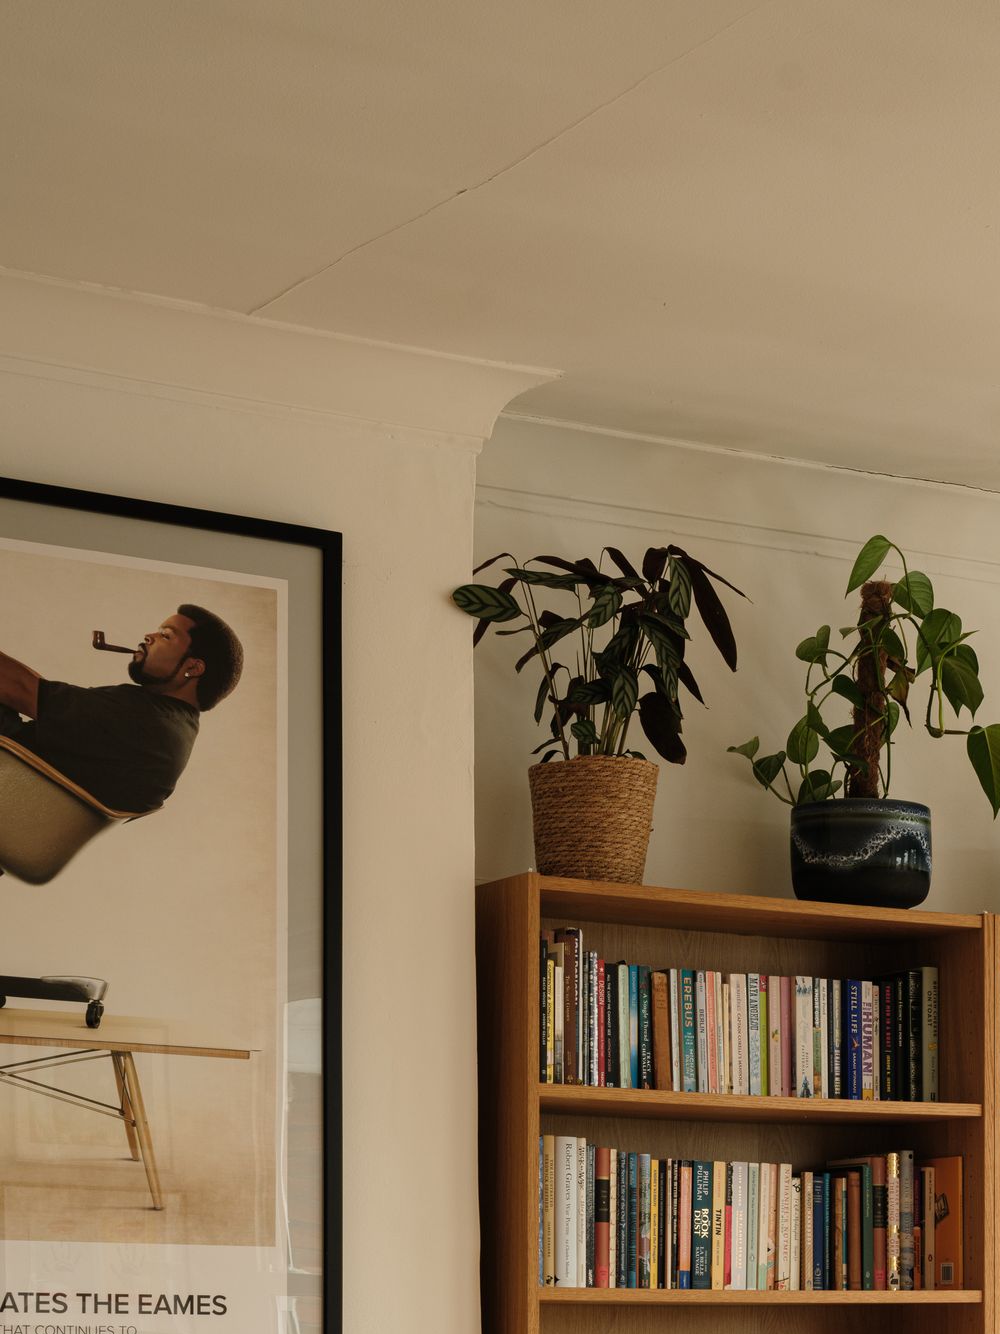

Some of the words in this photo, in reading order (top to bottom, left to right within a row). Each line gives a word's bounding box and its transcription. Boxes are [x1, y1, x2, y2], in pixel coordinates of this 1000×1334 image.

[749, 977, 759, 997] MAYA
[683, 977, 693, 1027] EREBUS
[749, 998, 760, 1031] ANGELOU
[863, 1011, 872, 1073] HUMAN
[565, 1143, 573, 1170] Robert
[565, 1172, 573, 1201] Graves
[693, 1210, 701, 1236] DUST
[701, 1208, 709, 1238] BOOK
[76, 1292, 129, 1315] THE
[138, 1294, 228, 1316] EAMES
